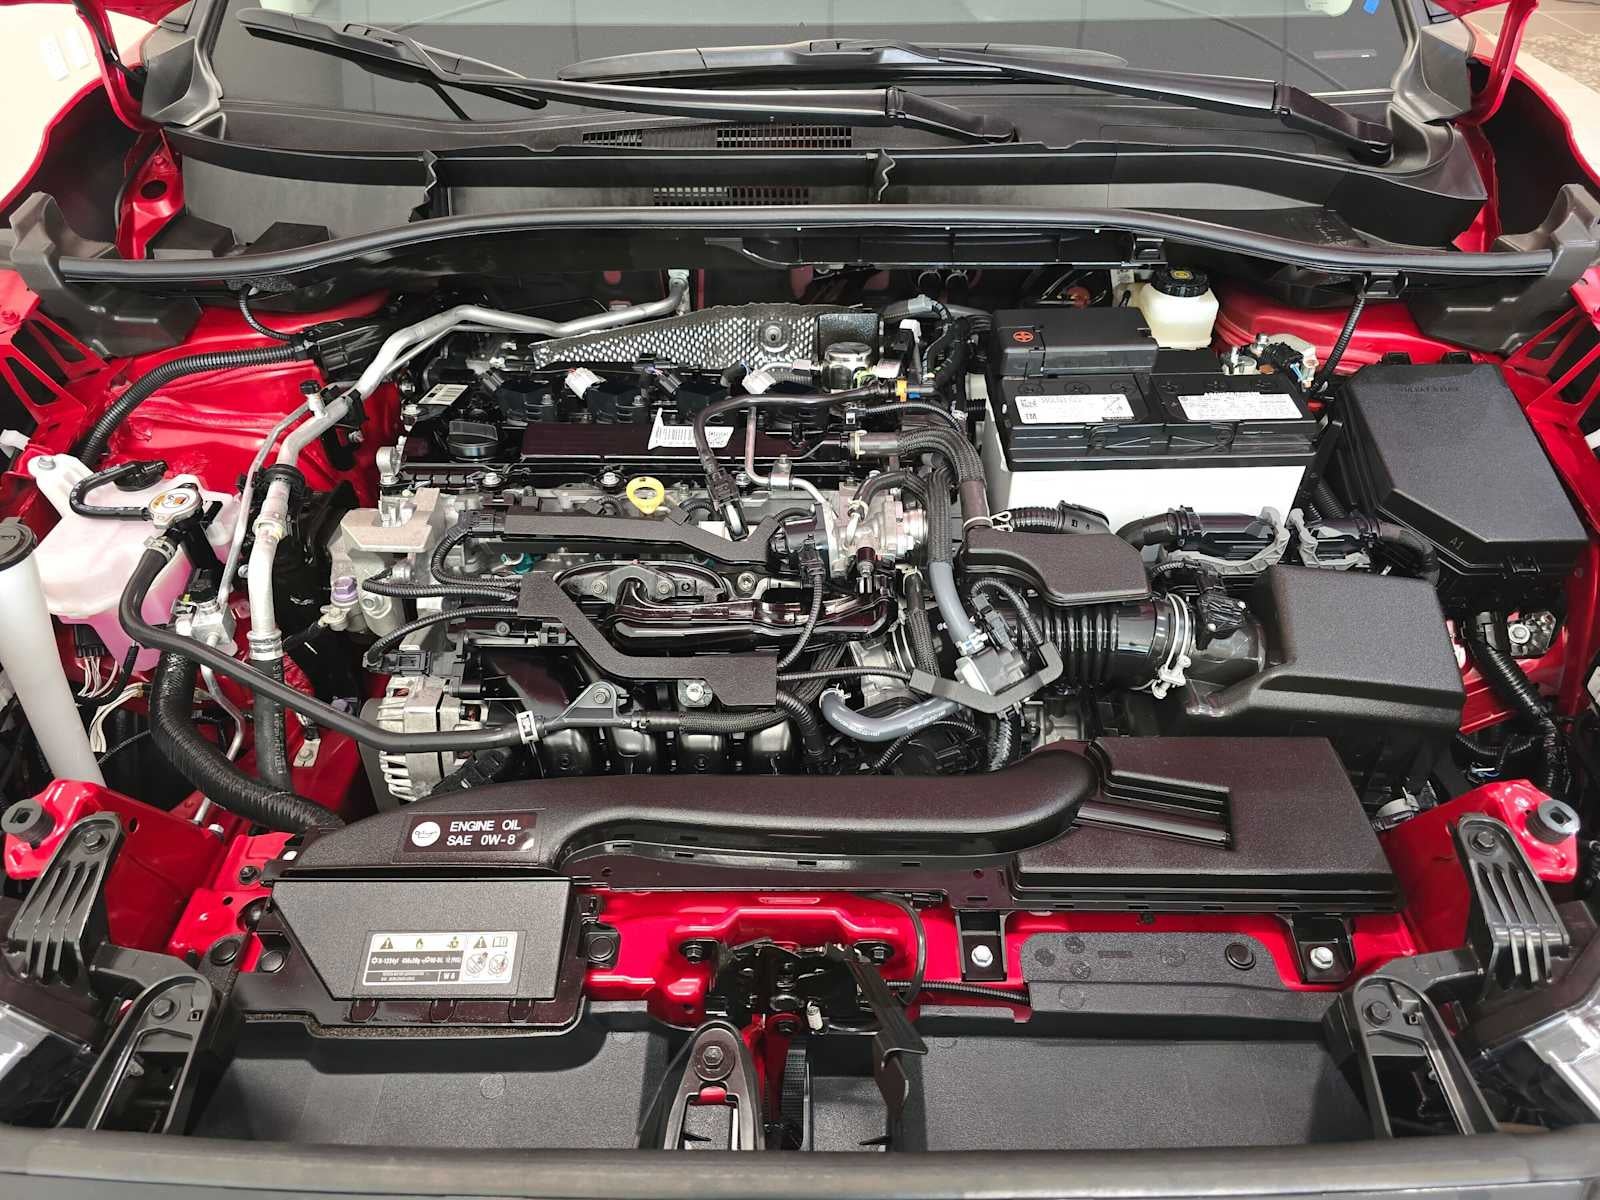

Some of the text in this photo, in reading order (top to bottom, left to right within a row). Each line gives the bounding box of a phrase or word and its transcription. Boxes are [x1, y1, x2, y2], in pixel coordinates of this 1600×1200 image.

[450, 819, 522, 832] ENGINE OIL
[446, 834, 517, 846] SAE 0W-8
